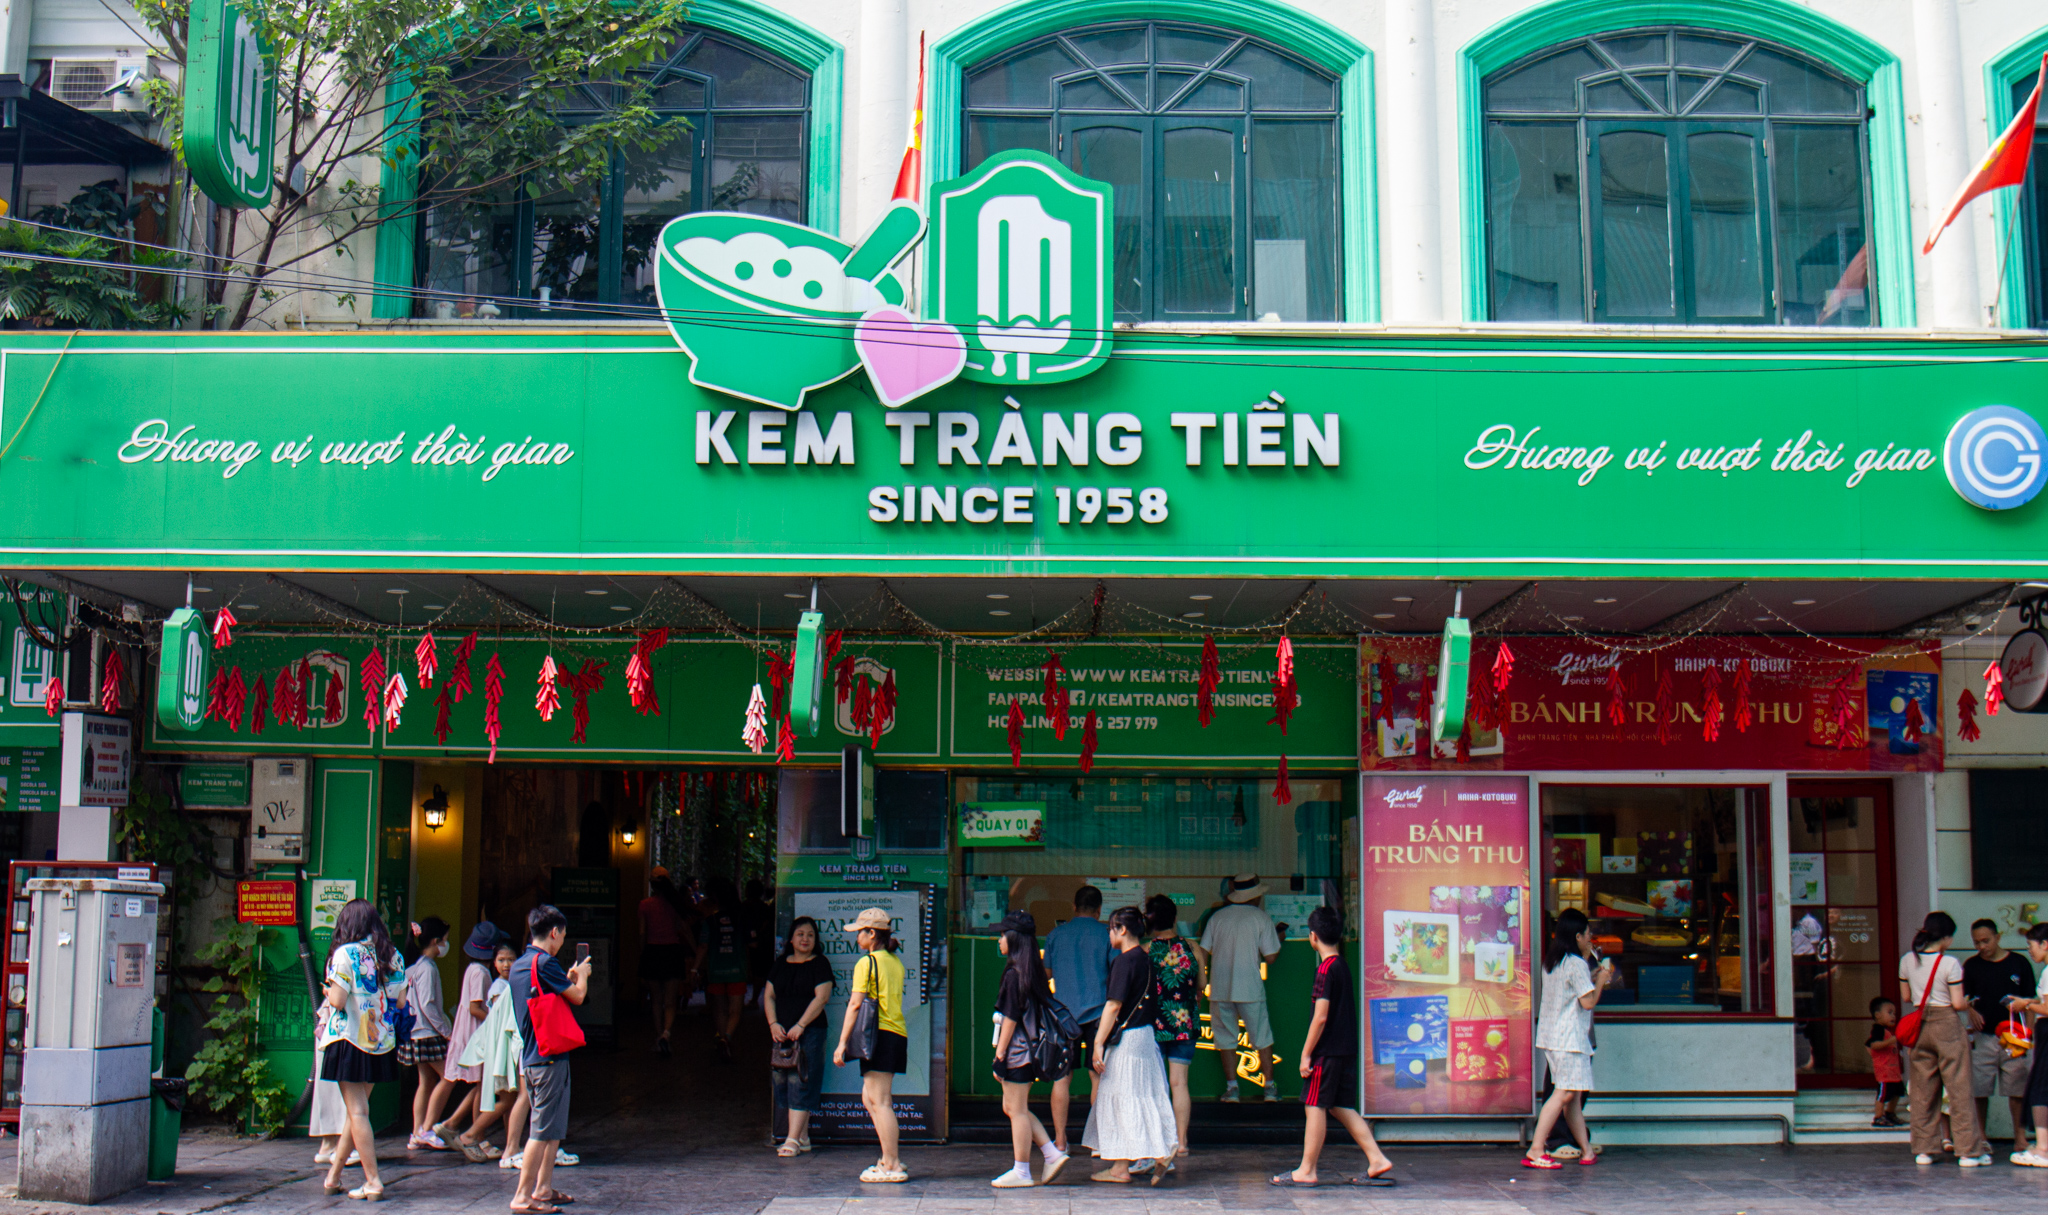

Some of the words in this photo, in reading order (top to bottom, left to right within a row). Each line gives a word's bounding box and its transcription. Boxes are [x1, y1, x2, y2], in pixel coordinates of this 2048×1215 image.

[695, 411, 856, 465] KEM
[884, 395, 1143, 466] TRÀNG
[1170, 390, 1340, 466] TIỀN
[117, 419, 262, 479] Hương
[271, 433, 314, 470] vị
[319, 432, 406, 471] vượt
[410, 424, 486, 466] thời
[482, 436, 575, 482] gian
[1463, 424, 1614, 487] Hương
[1624, 440, 1667, 477] vị
[1676, 438, 1764, 478] vượt
[1770, 429, 1846, 473] thời
[1846, 434, 1937, 489] gian
[868, 486, 1034, 523] SINCE
[1055, 487, 1169, 523] 1958
[1592, 676, 1608, 686] 195
[988, 692, 1060, 706] FANPA
[1510, 693, 1601, 723] BÁNH
[1747, 701, 1803, 724] HU
[1069, 716, 1104, 730] 096
[1107, 716, 1132, 730] 257
[1134, 716, 1159, 730] 979
[1457, 793, 1517, 802] HAIHA-KOTOBUKI
[1015, 818, 1028, 831] 01
[1409, 818, 1483, 843] BÁNH
[1368, 845, 1460, 865] TRUNG
[1467, 845, 1524, 865] THU
[819, 864, 842, 873] KEM
[845, 861, 881, 874] TRÀNG
[883, 862, 908, 874] TIỀN
[867, 874, 884, 882] 1958
[323, 885, 346, 894] KEM
[828, 897, 846, 905] KHÉP
[847, 898, 860, 906] MỘT
[846, 1110, 864, 1118] KEM
